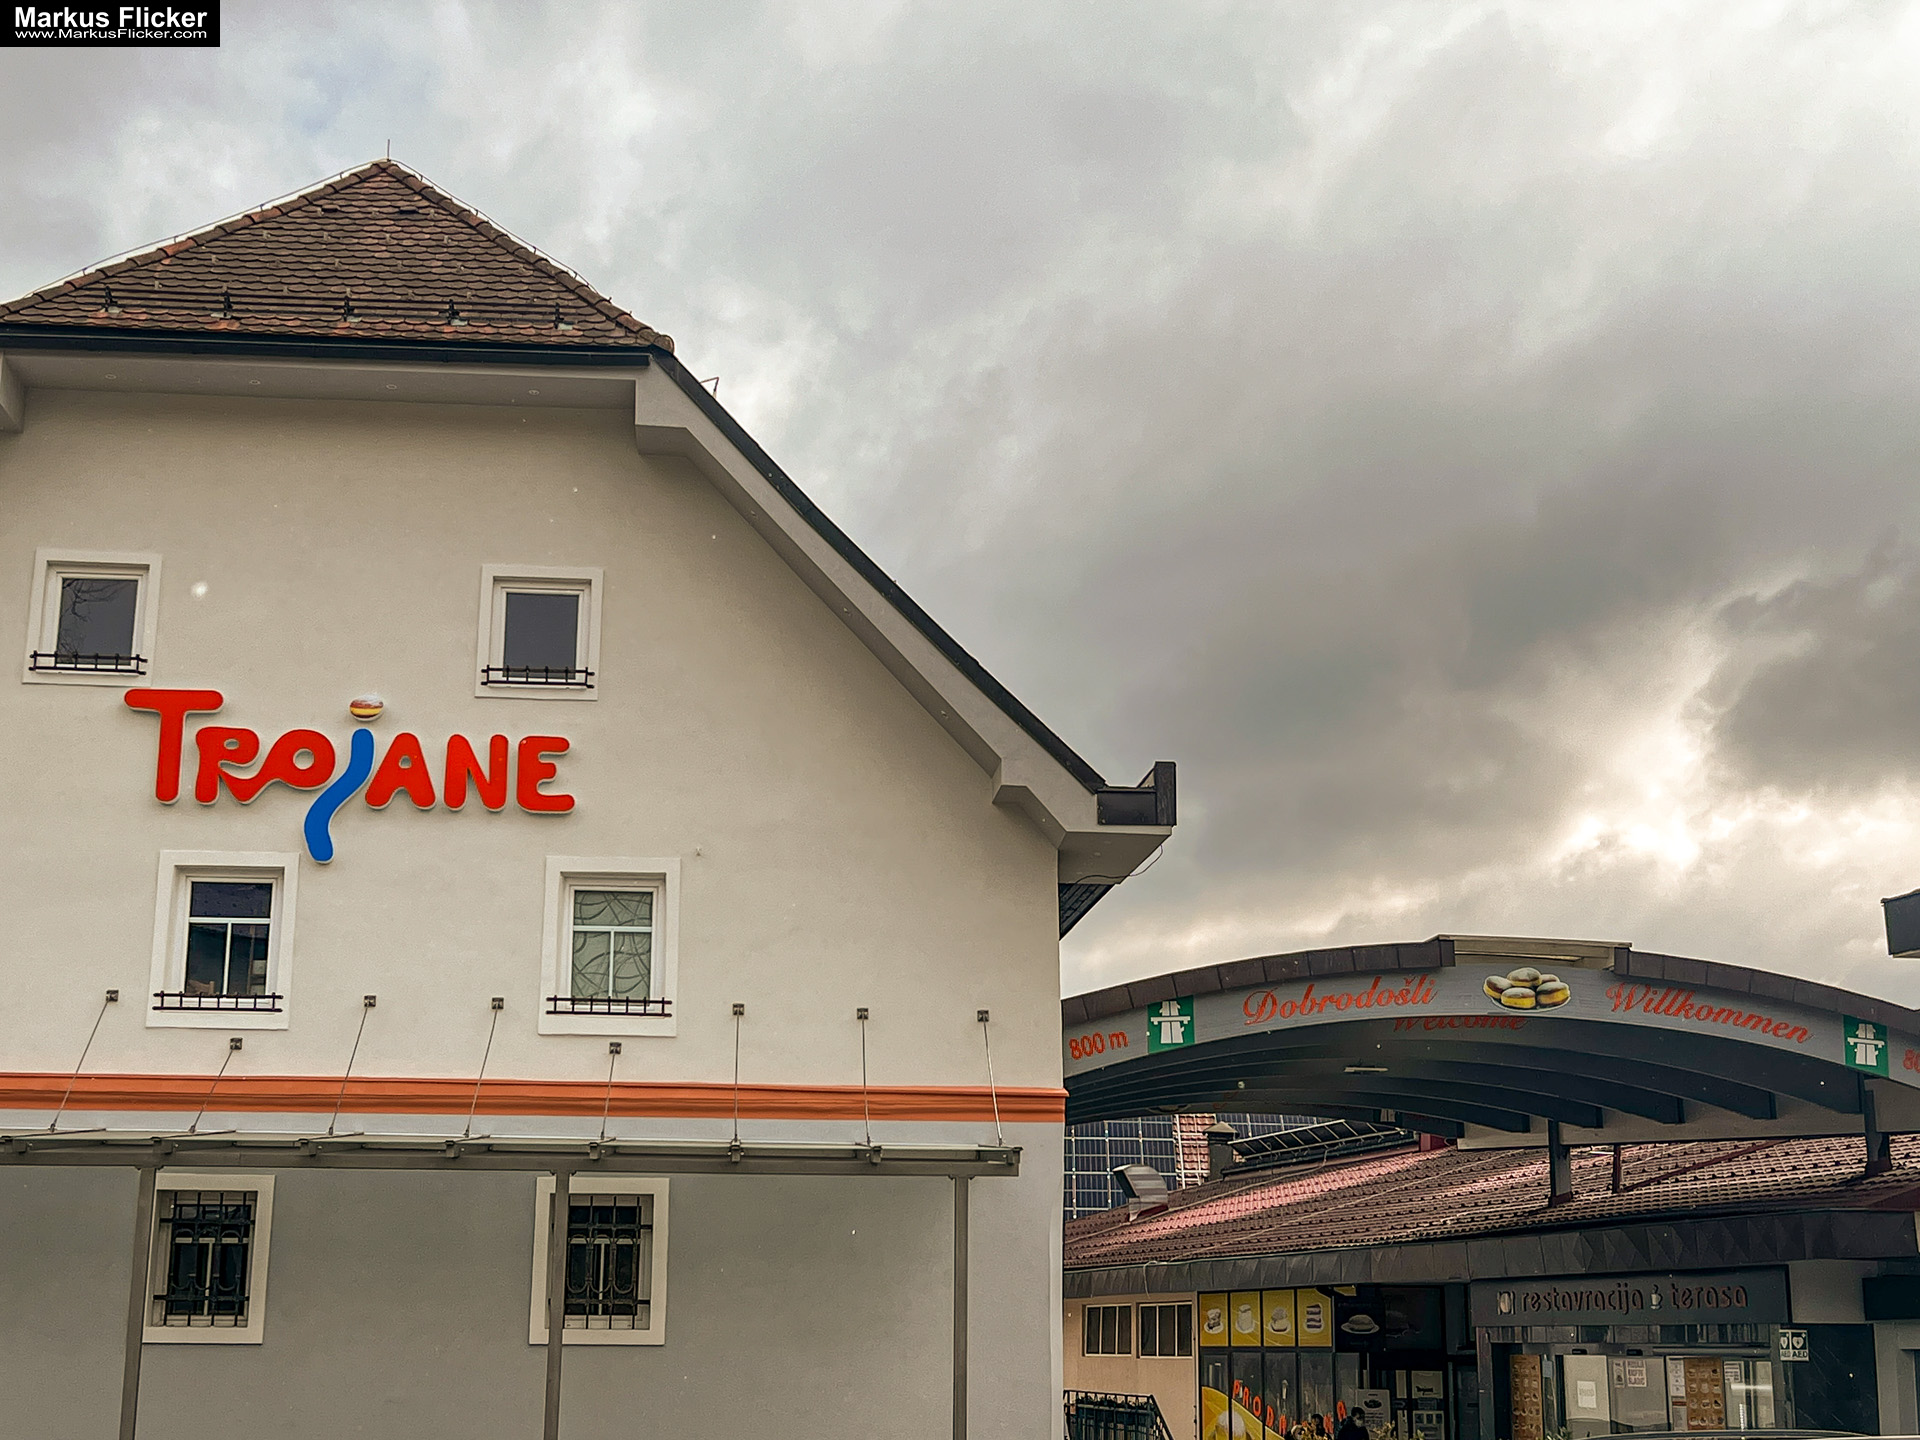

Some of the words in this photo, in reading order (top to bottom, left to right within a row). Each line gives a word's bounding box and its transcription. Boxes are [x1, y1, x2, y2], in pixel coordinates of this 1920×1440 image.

[1243, 973, 1438, 1026] Dobrodošli
[1605, 981, 1813, 1044] Willkommen
[1069, 1032, 1106, 1060] 800
[1108, 1031, 1128, 1050] m
[1522, 1281, 1644, 1316] restavracija
[1671, 1281, 1748, 1310] terasa
[1792, 1350, 1808, 1358] AED
